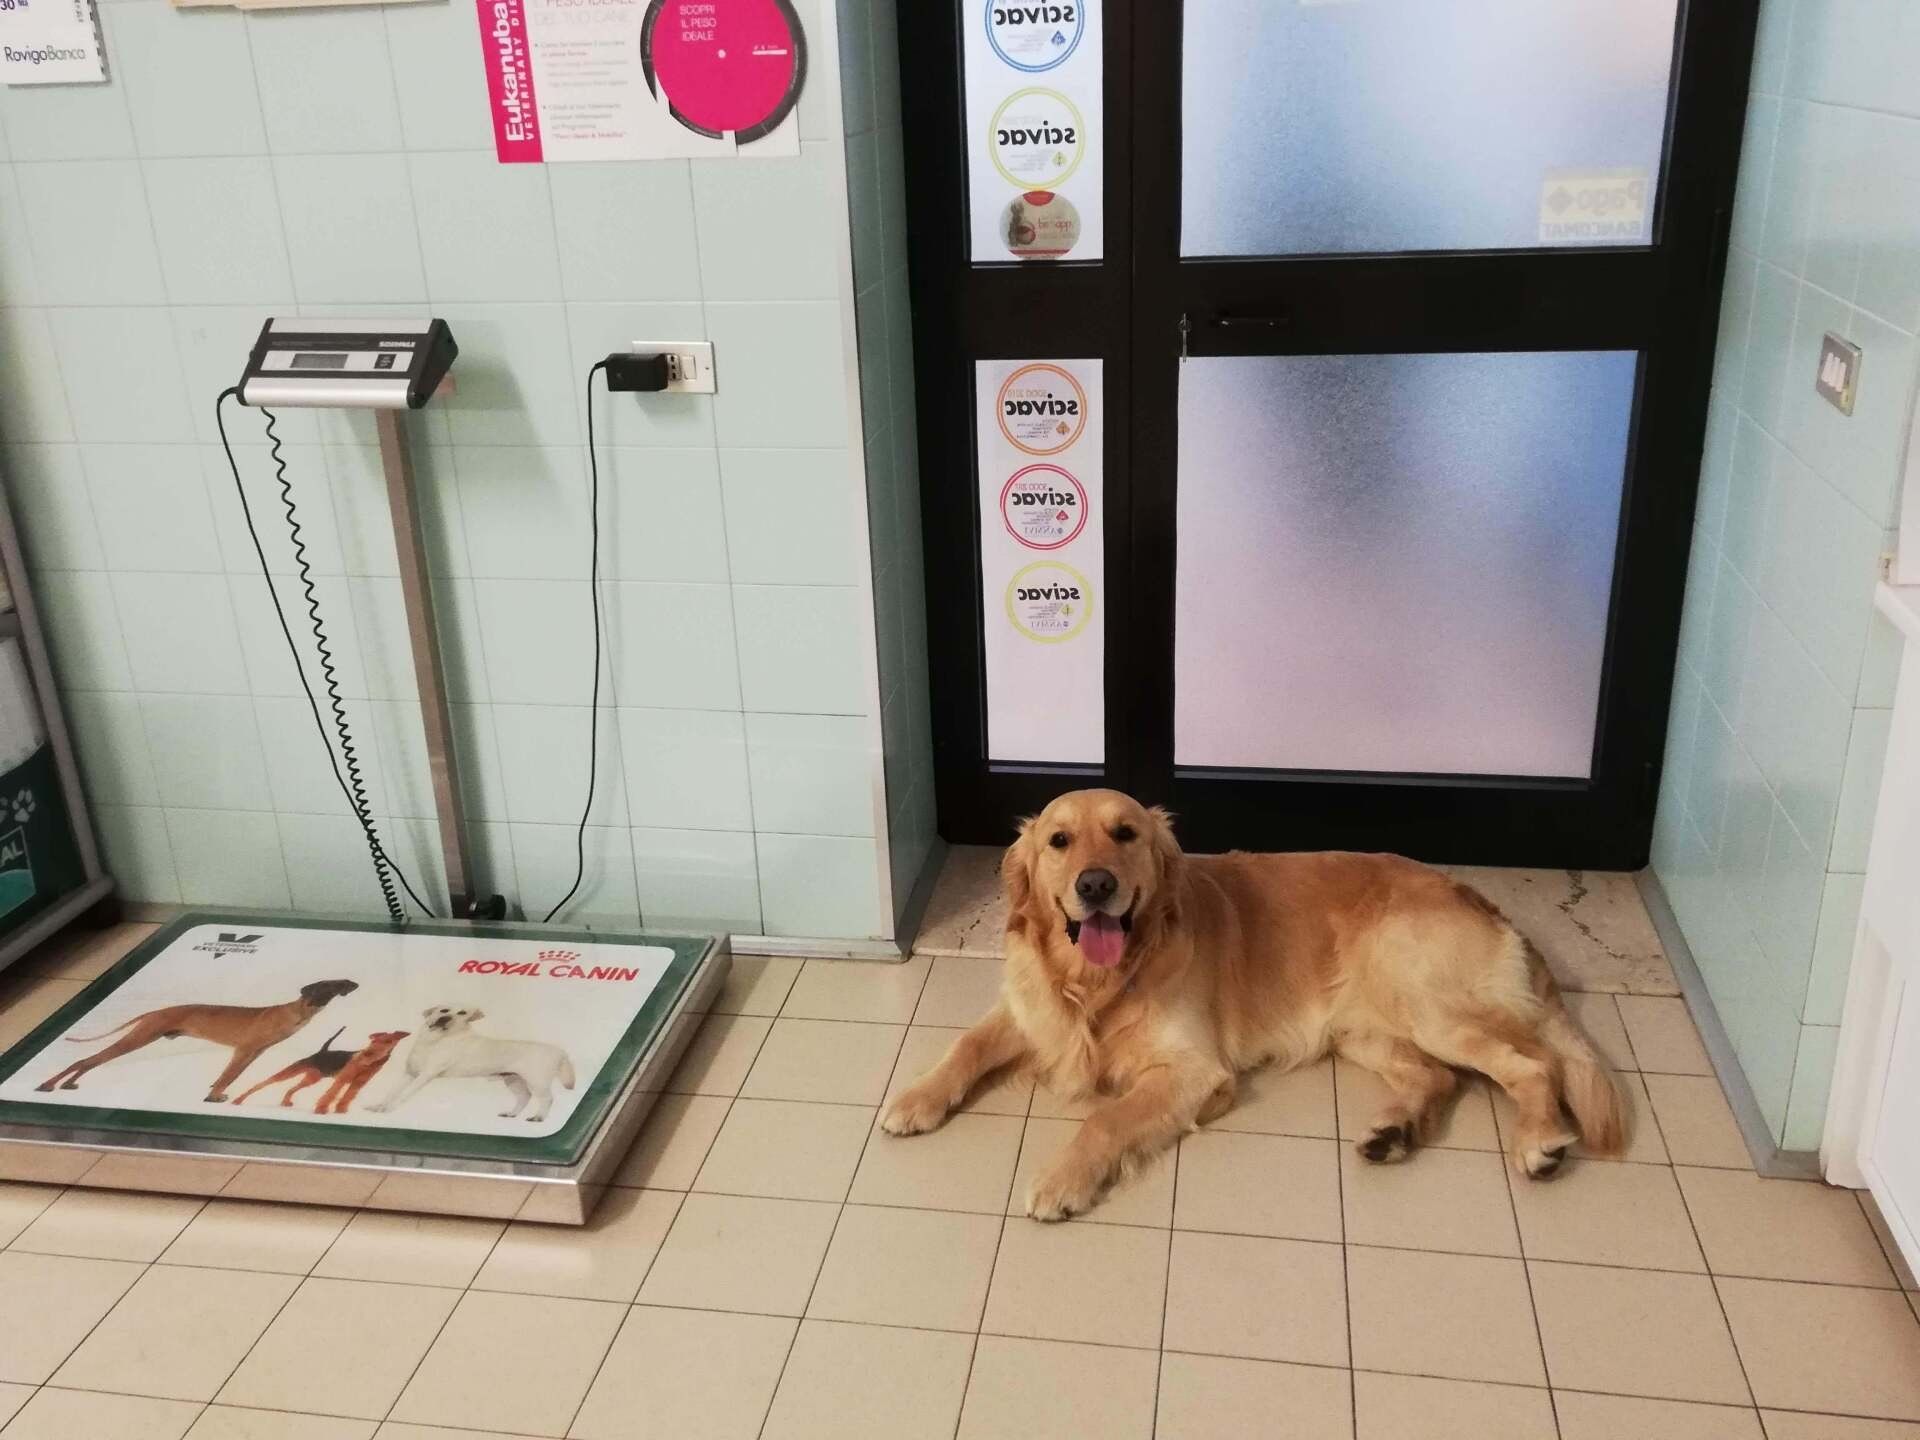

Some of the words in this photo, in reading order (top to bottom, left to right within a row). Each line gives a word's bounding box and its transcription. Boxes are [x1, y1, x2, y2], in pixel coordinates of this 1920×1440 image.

[680, 5, 715, 15] SCOPRI
[681, 19, 689, 28] IL
[691, 17, 717, 28] PESO
[682, 31, 714, 41] IDEALE
[493, 2, 525, 141] Eukanuba
[512, 37, 535, 140] VETERINARY
[458, 960, 540, 976] ROYAL
[549, 965, 640, 981] CANIN
